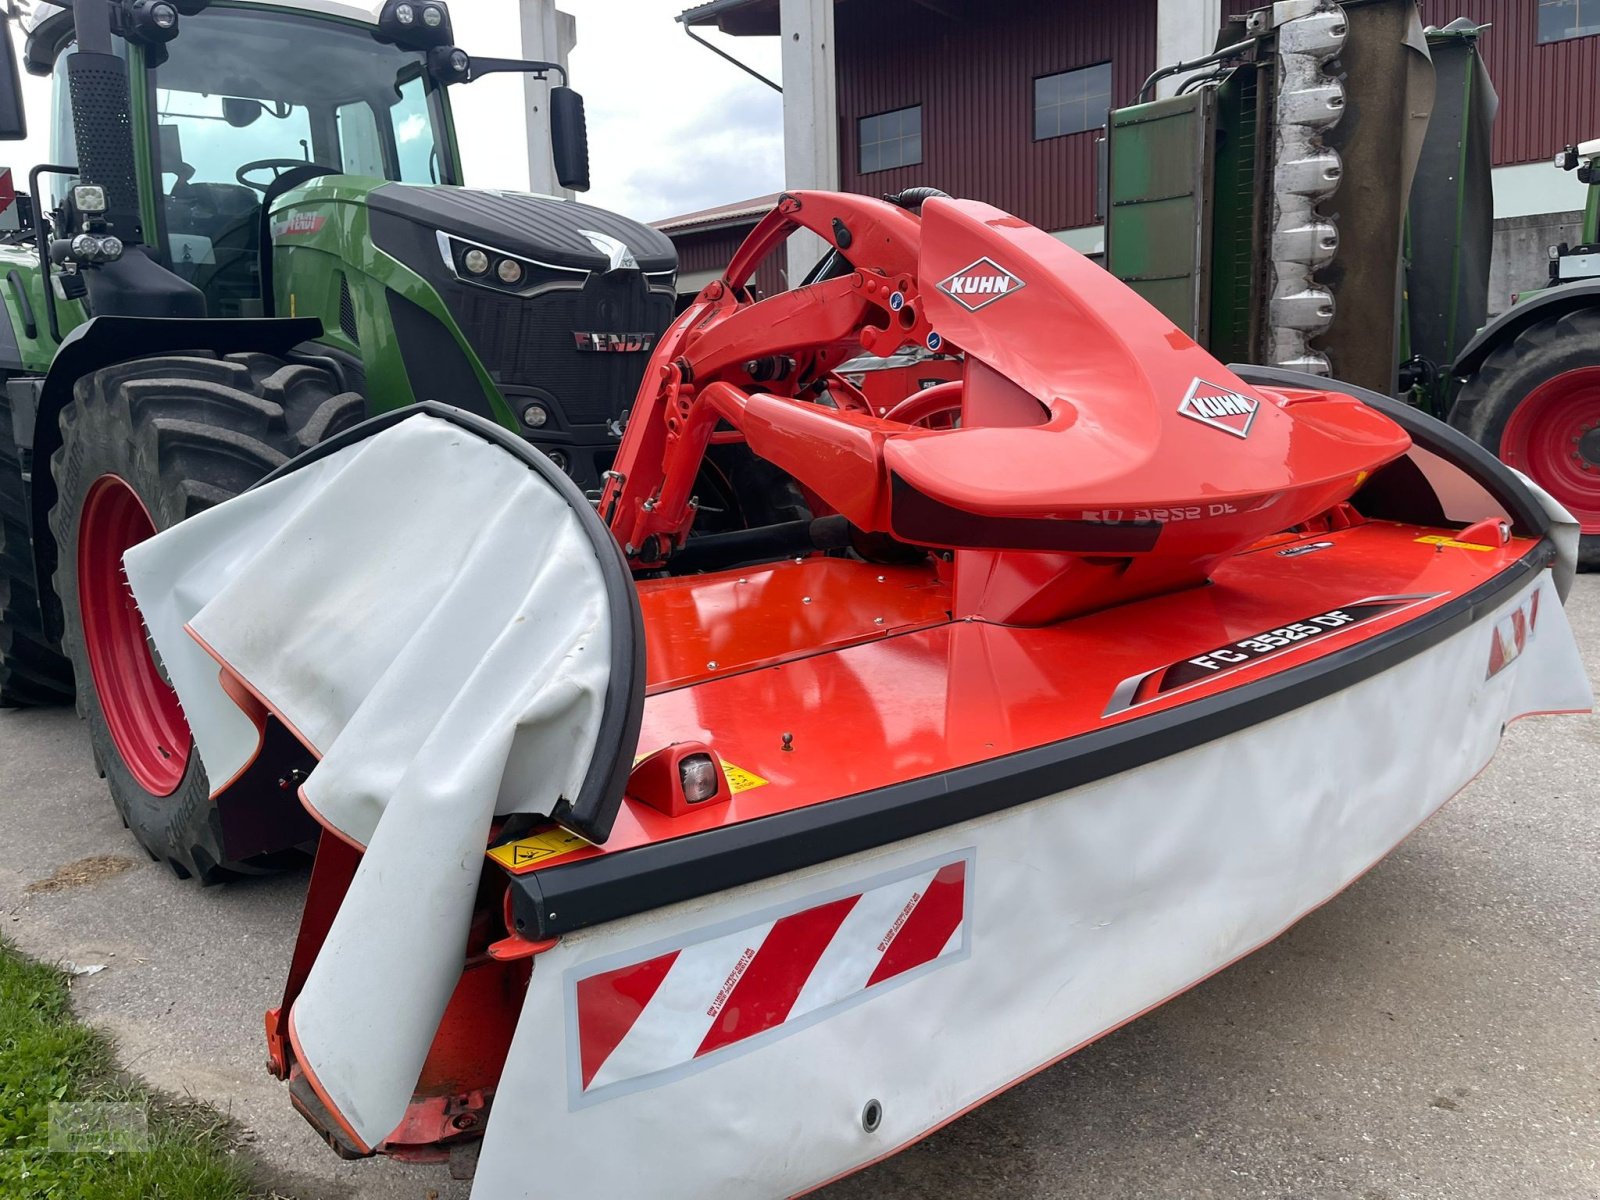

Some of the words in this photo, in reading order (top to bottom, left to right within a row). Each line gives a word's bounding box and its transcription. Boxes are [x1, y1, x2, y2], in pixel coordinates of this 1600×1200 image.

[950, 276, 1010, 294] KUHN
[574, 331, 655, 352] FENDT
[1190, 393, 1255, 418] KUHN
[1188, 649, 1249, 670] FC
[1236, 623, 1323, 653] 3525
[1310, 610, 1354, 627] DF
